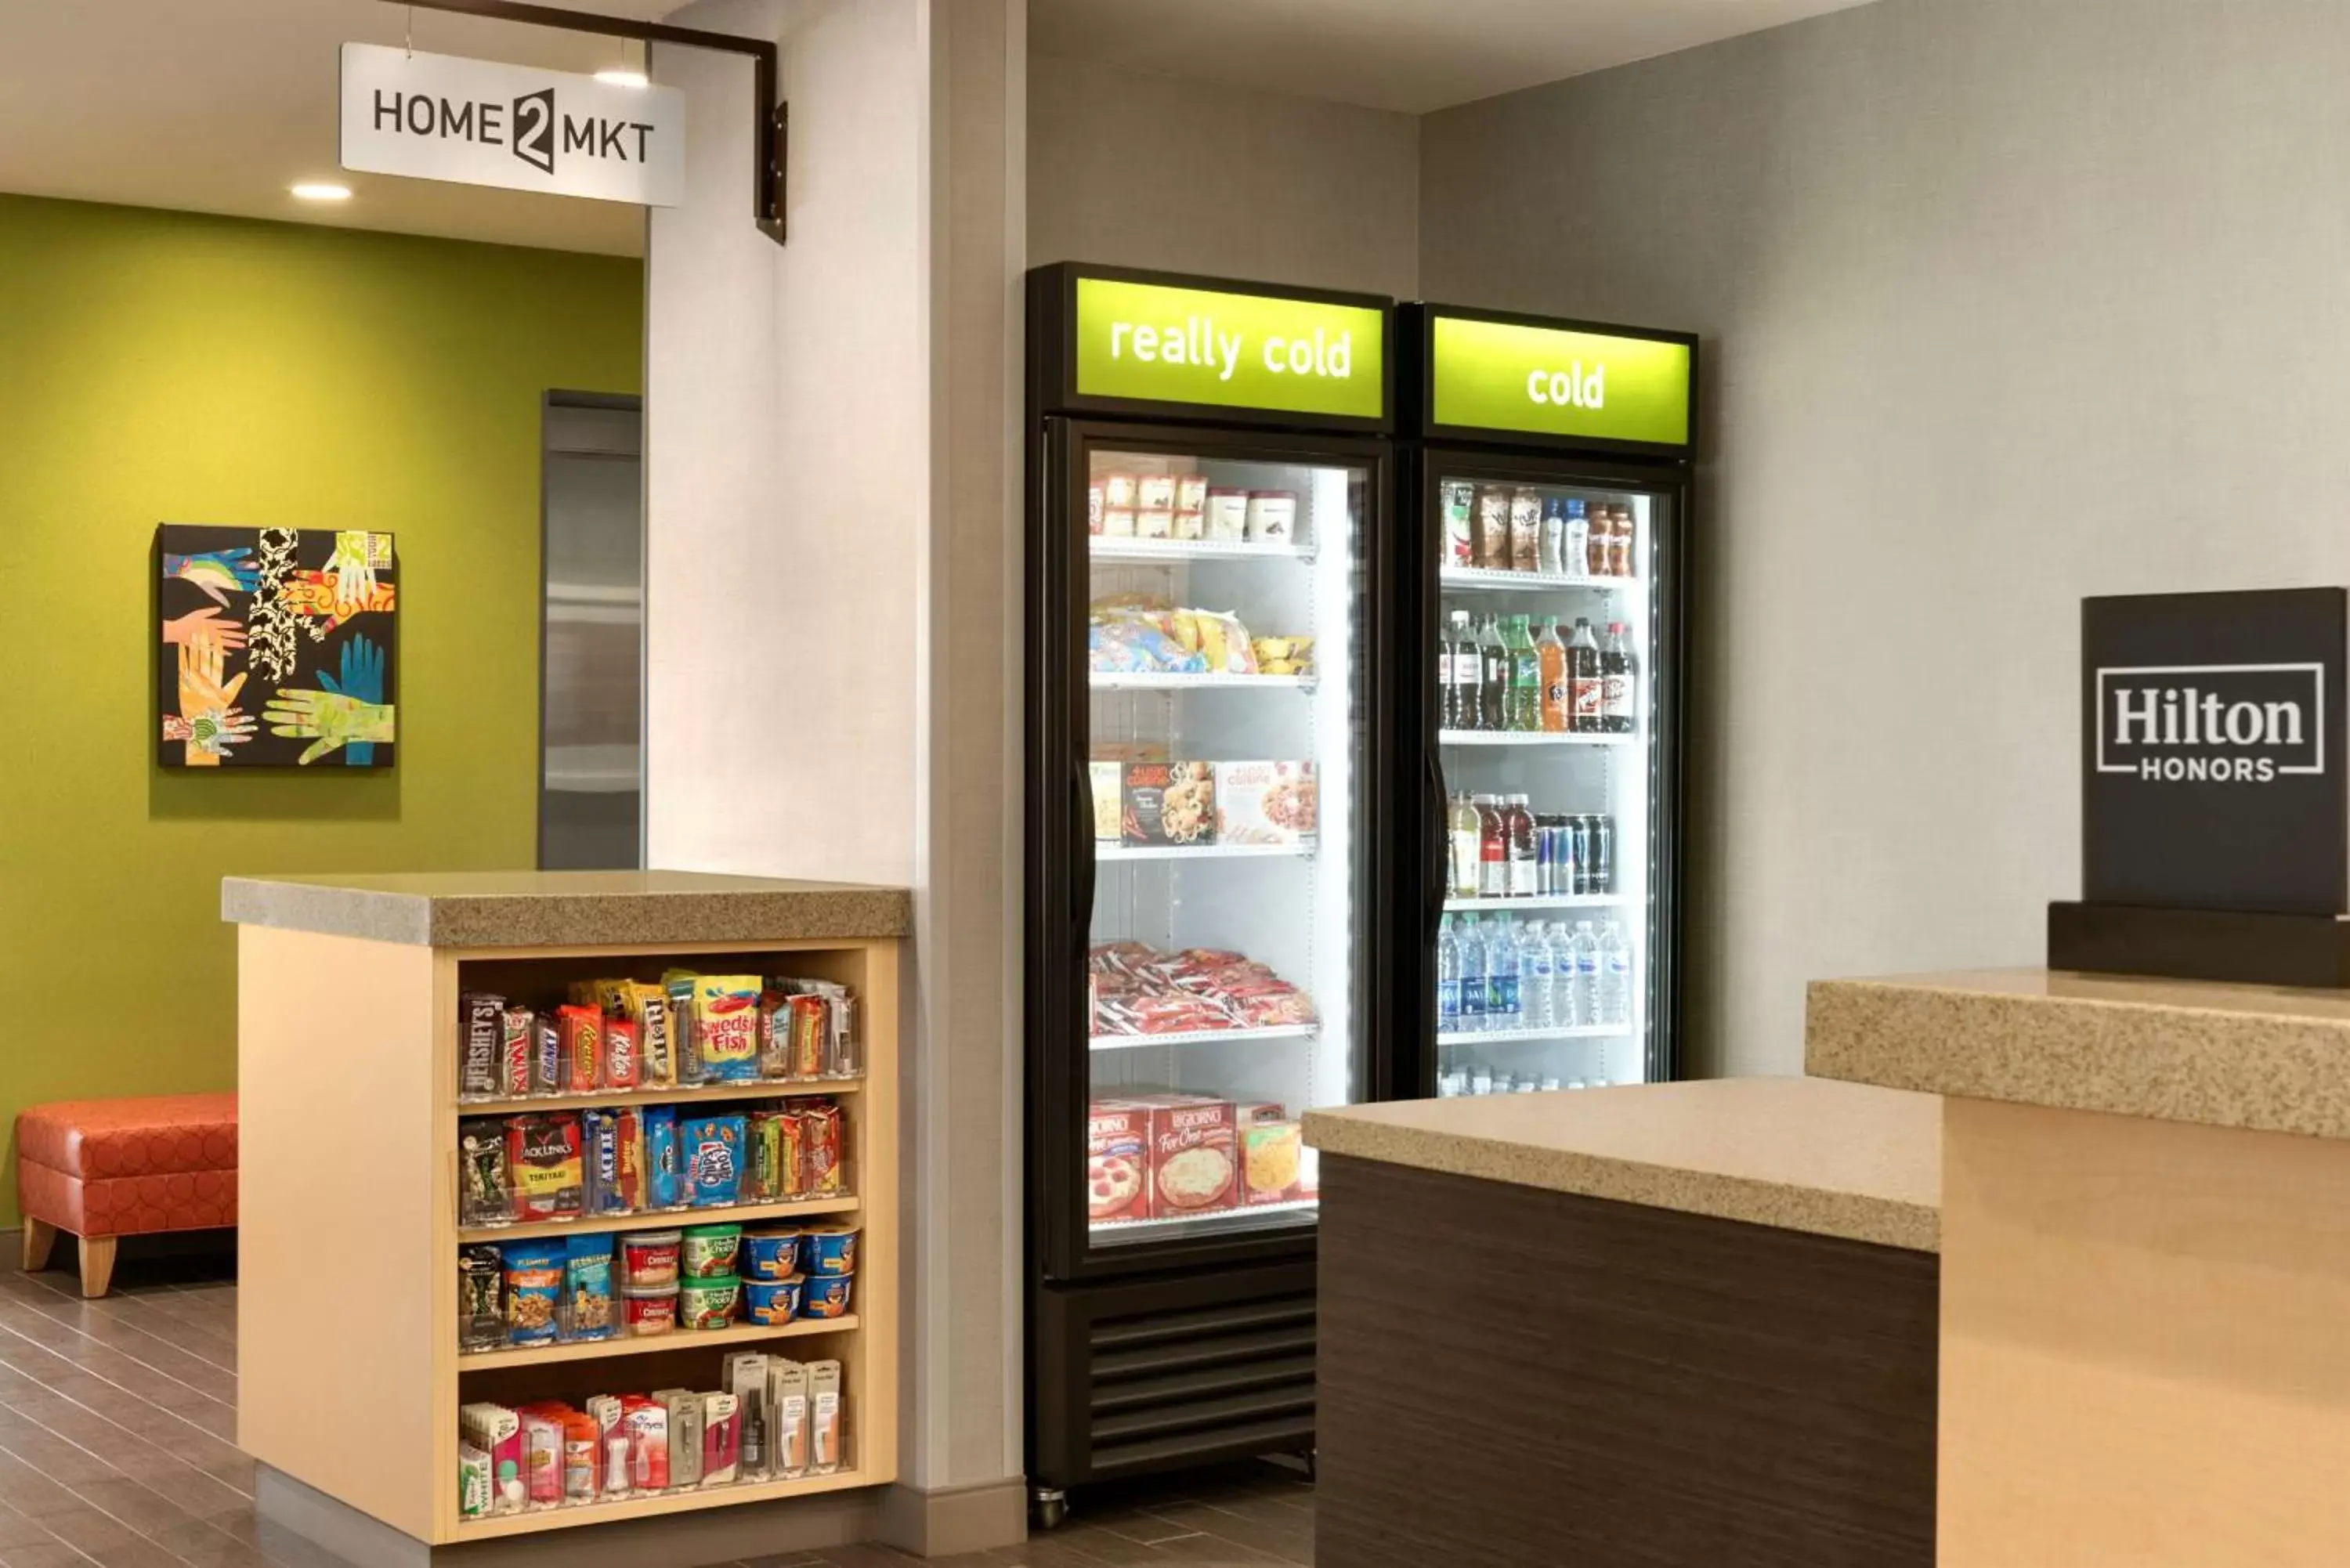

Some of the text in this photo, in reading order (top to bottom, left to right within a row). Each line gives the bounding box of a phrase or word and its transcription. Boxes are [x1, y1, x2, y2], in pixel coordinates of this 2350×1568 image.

[1109, 315, 1352, 381] really cold
[1526, 360, 1606, 410] cold
[2114, 687, 2304, 746] Hilton
[2141, 757, 2275, 782] HONORS
[509, 1032, 531, 1092] TWIX
[711, 1034, 748, 1055] Fish
